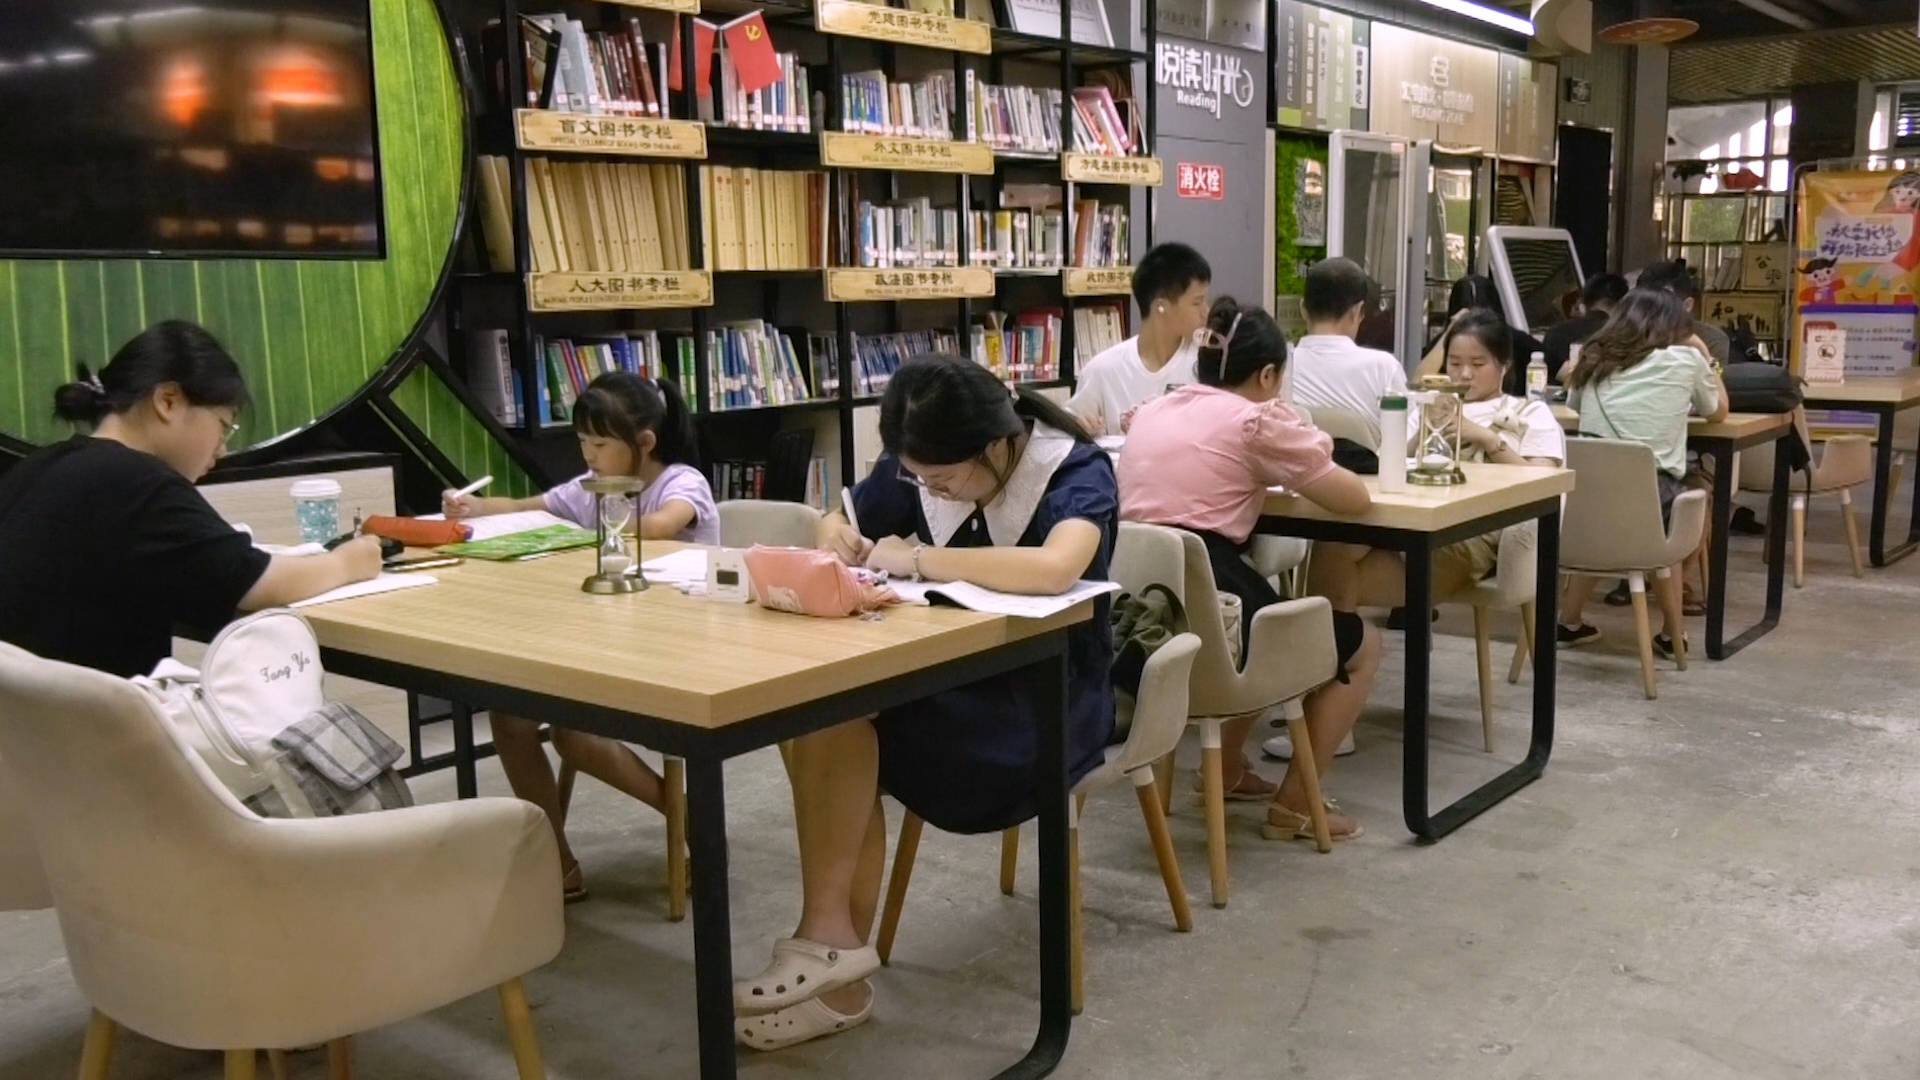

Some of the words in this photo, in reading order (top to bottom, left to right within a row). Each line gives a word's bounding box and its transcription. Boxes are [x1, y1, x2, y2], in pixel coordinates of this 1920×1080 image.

[1155, 42, 1254, 119] 悦读时光
[1177, 90, 1217, 113] Reading
[559, 119, 673, 140] 盲文图书专栏
[873, 142, 952, 157] 外文图书专栏
[1180, 167, 1220, 192] 消火栓
[568, 277, 681, 293] 人大图书专栏
